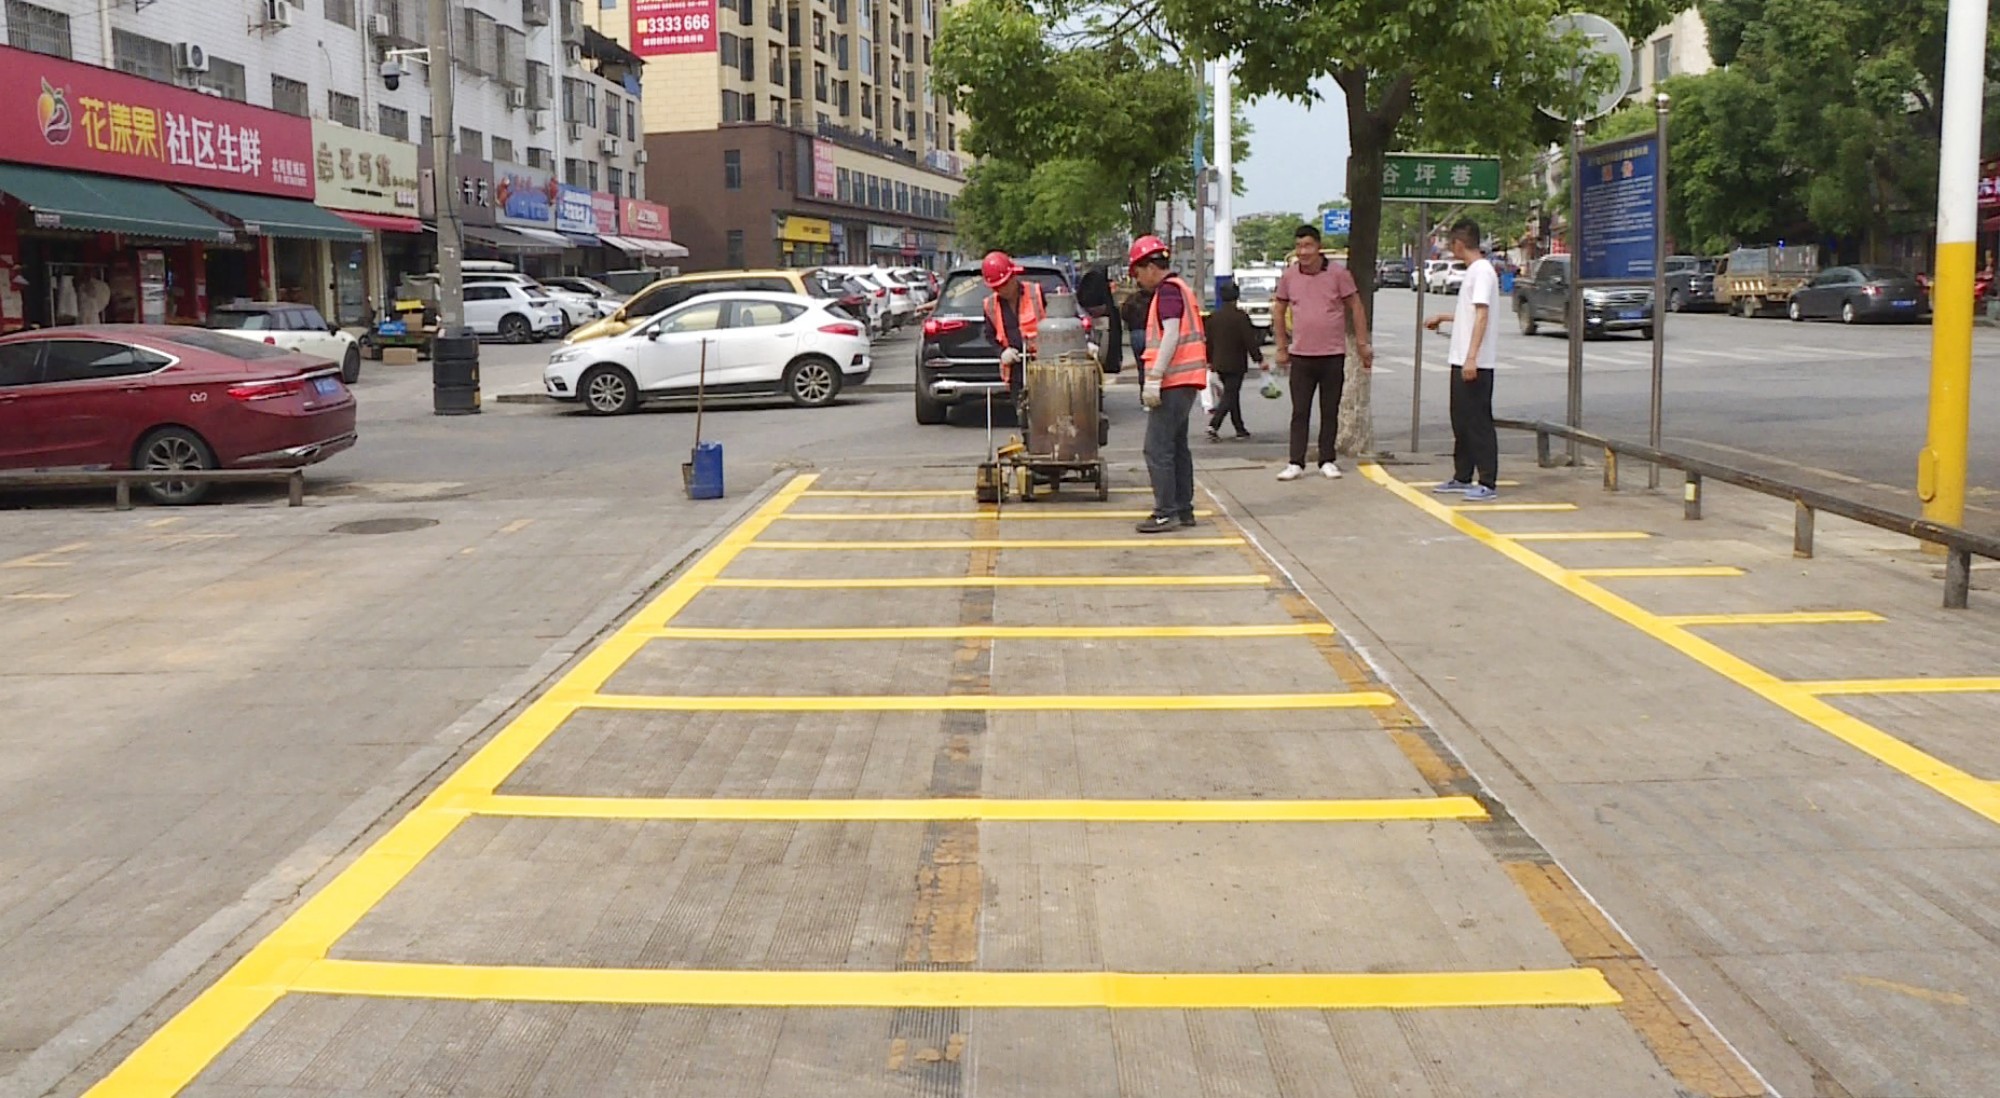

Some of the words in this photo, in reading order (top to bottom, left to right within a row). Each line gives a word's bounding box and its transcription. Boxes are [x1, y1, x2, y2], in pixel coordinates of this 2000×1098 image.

[648, 15, 681, 33] 3333
[684, 14, 709, 30] 666
[165, 111, 262, 176] 社区生鲜
[1382, 163, 1472, 186] 谷坪巷
[1383, 187, 1399, 195] GU
[1404, 187, 1430, 195] PING
[1436, 188, 1465, 196] HANG
